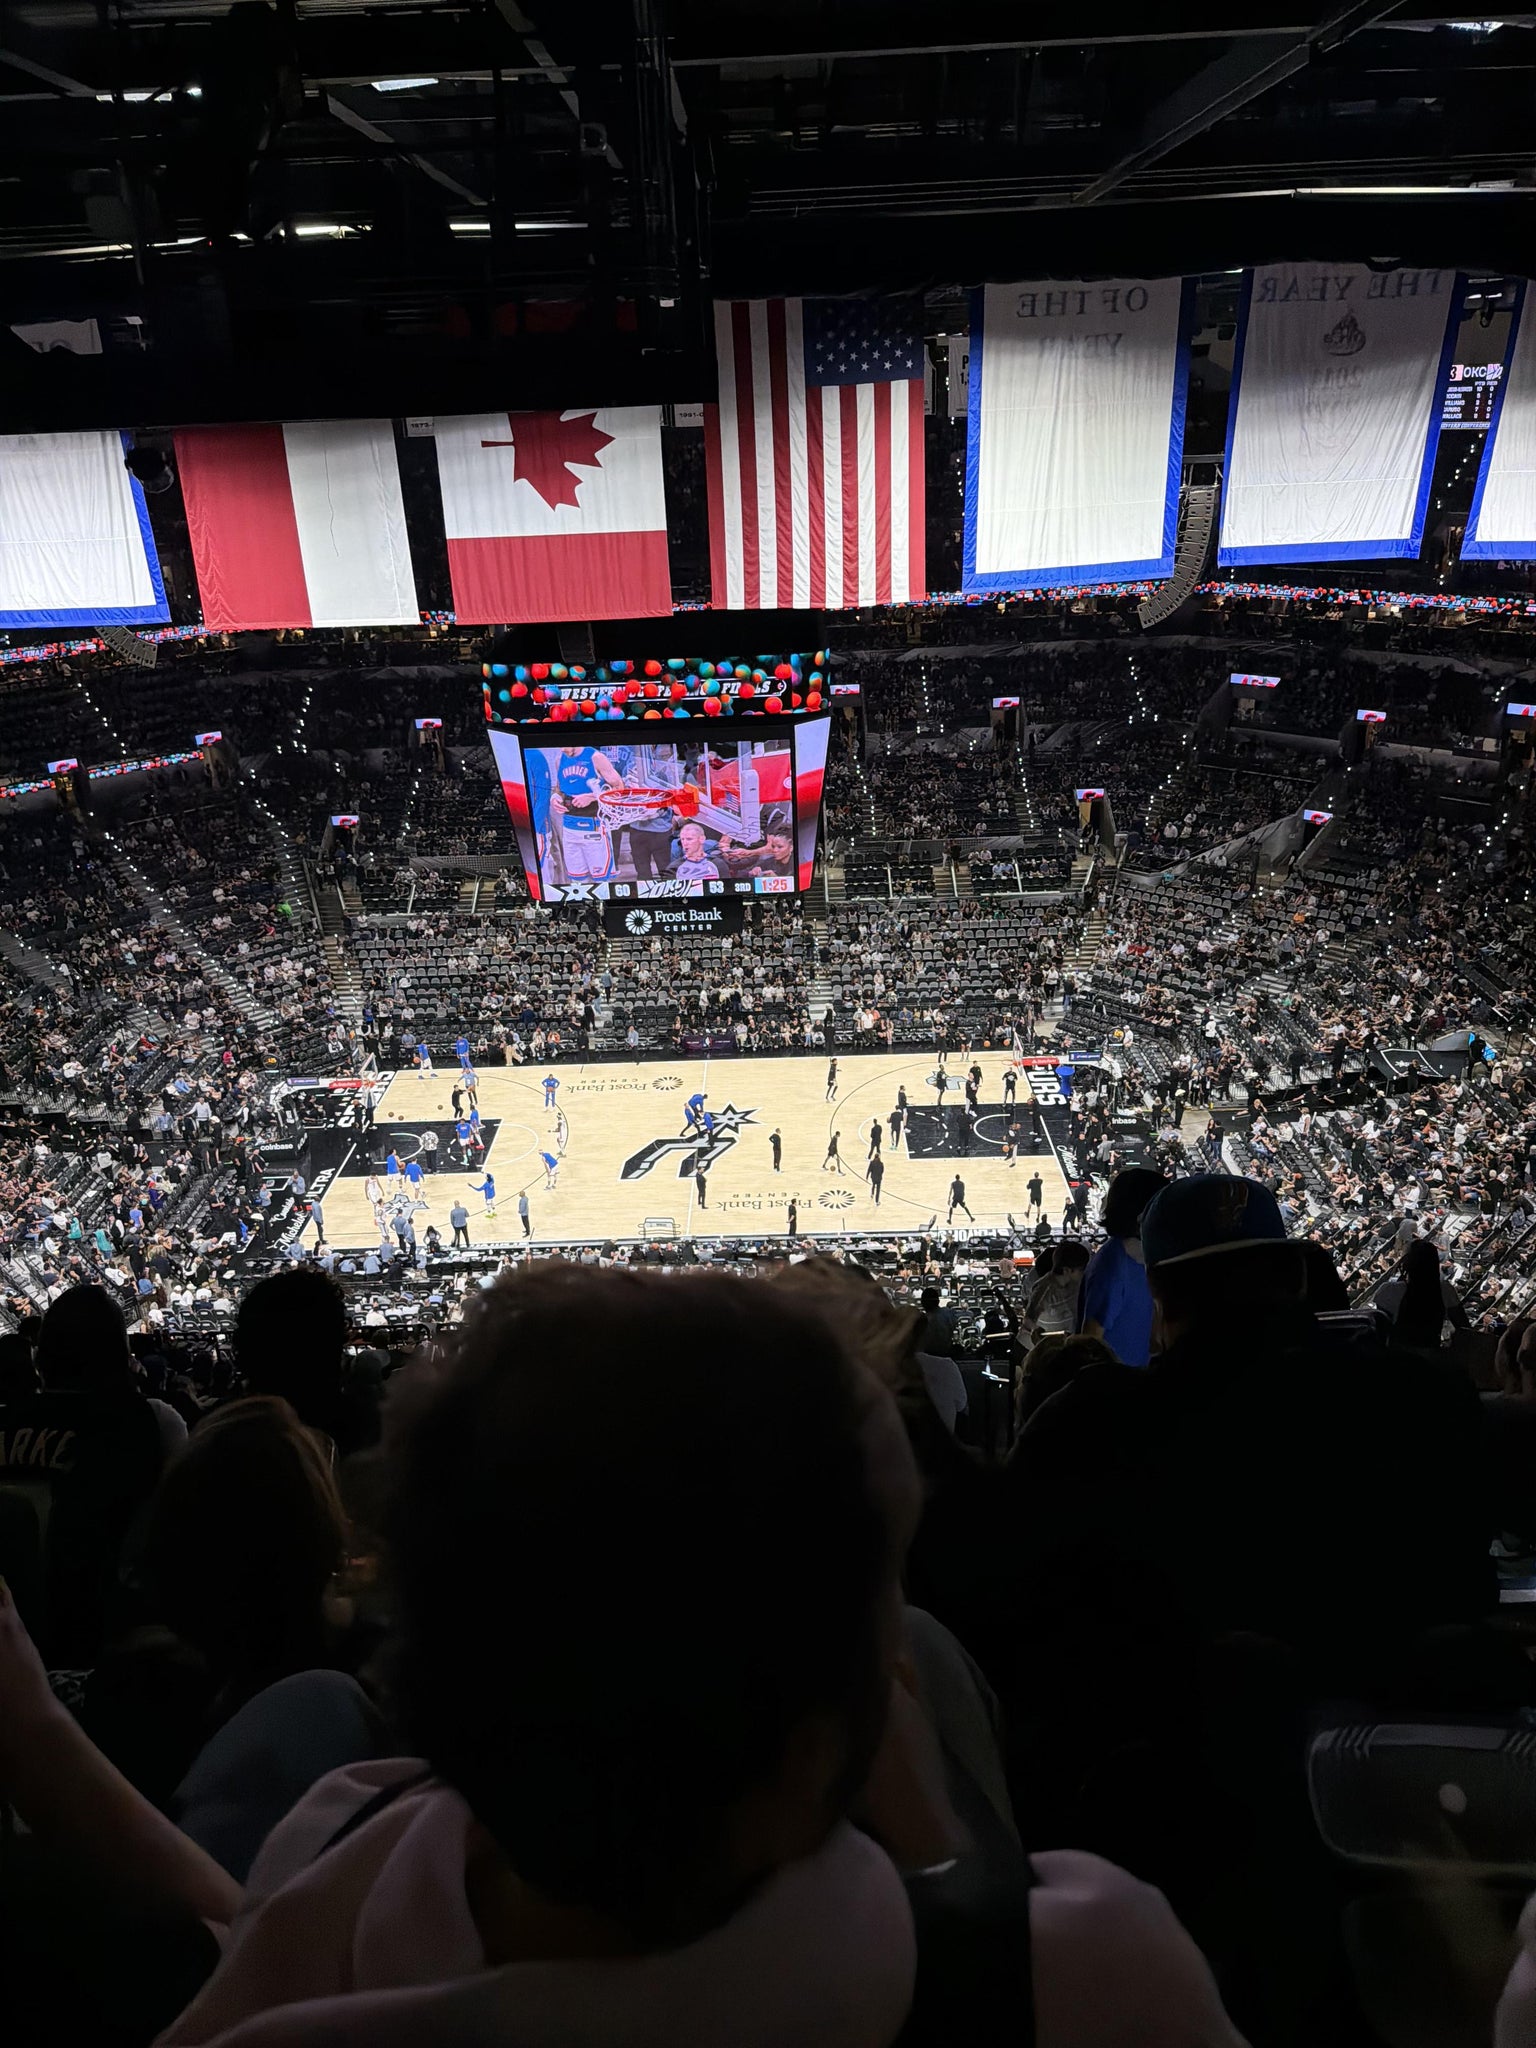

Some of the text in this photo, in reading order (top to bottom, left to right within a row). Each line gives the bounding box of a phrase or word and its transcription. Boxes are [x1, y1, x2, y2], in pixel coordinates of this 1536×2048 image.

[1463, 366, 1487, 378] OKC
[614, 884, 631, 897] 60
[709, 880, 724, 894] 53
[734, 882, 751, 893] 3RD
[761, 878, 788, 892] 1:25
[654, 907, 723, 923] Frost Bank
[664, 924, 712, 932] CENTER
[565, 1083, 649, 1093] Frost Bank
[260, 1143, 294, 1151] coinbase
[715, 1200, 762, 1211] Bank
